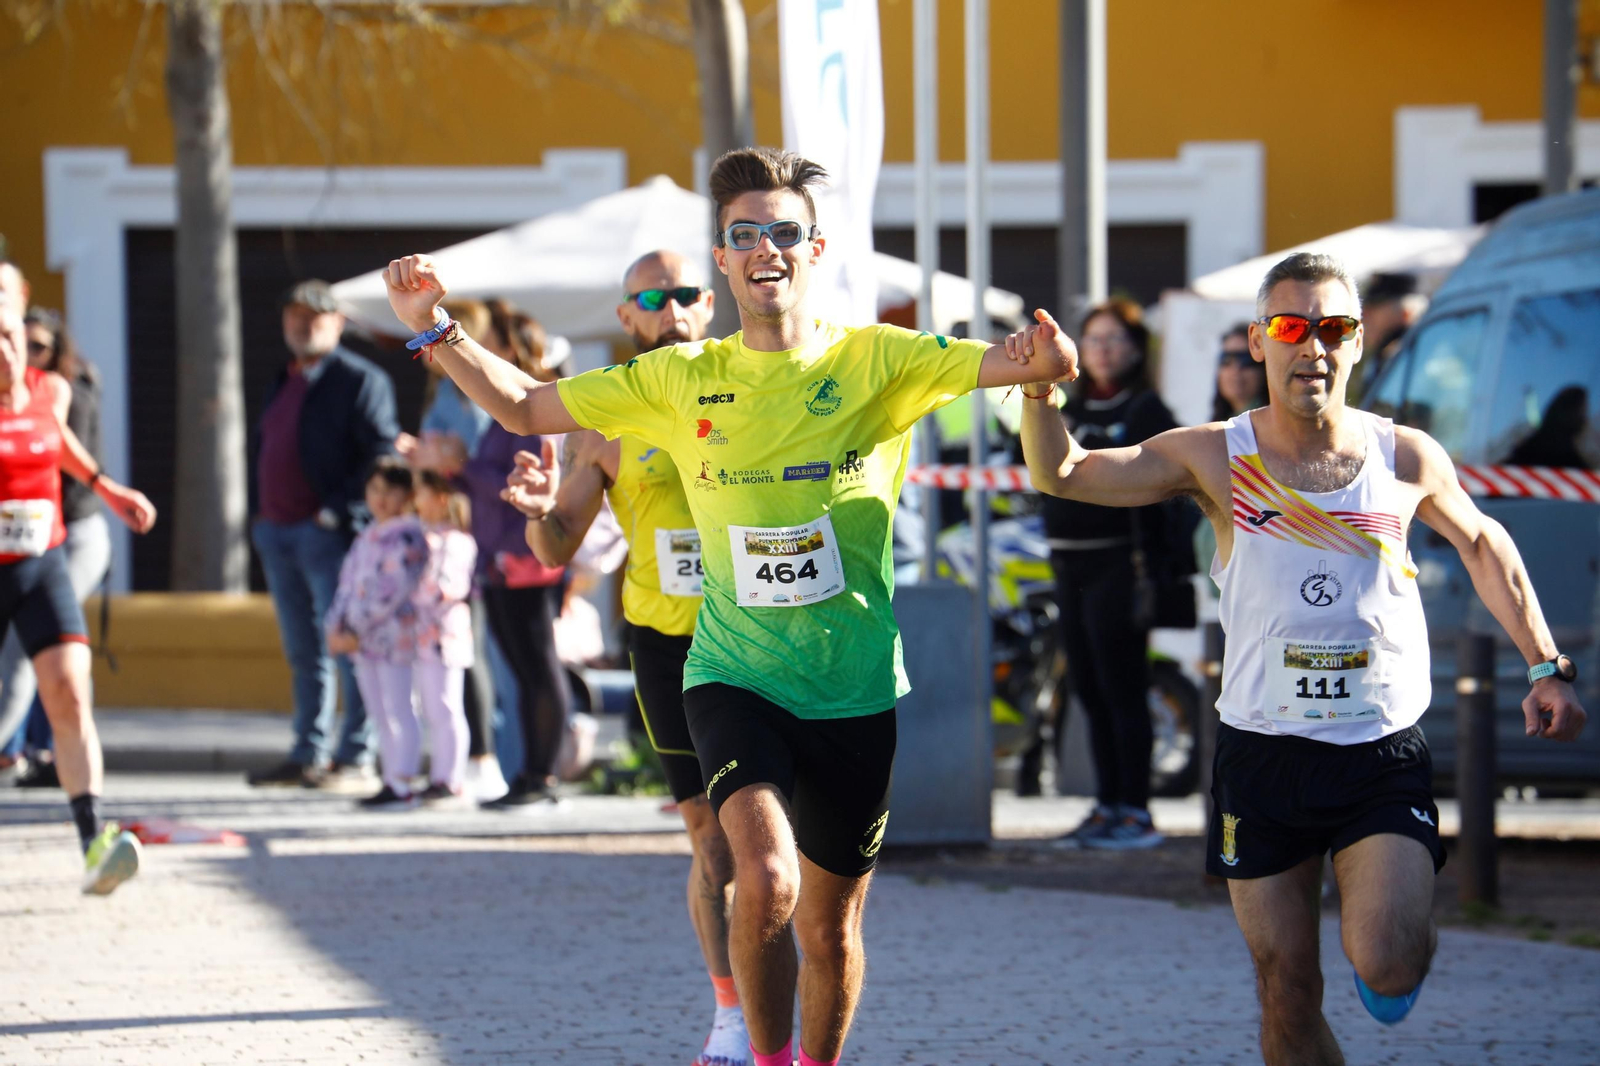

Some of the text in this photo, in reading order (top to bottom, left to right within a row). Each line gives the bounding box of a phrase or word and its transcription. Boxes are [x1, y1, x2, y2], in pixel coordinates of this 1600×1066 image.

[706, 436, 729, 446] Smith
[732, 469, 771, 477] BODEGAS
[729, 475, 775, 485] EL MONTE
[838, 473, 865, 484] RIADA
[781, 527, 809, 537] POPULAR
[768, 543, 798, 554] XXIII
[755, 558, 819, 584] 464
[1298, 643, 1356, 651] CARRERA POPULAR
[1310, 658, 1342, 668] XXIII
[1296, 676, 1350, 700] 111
